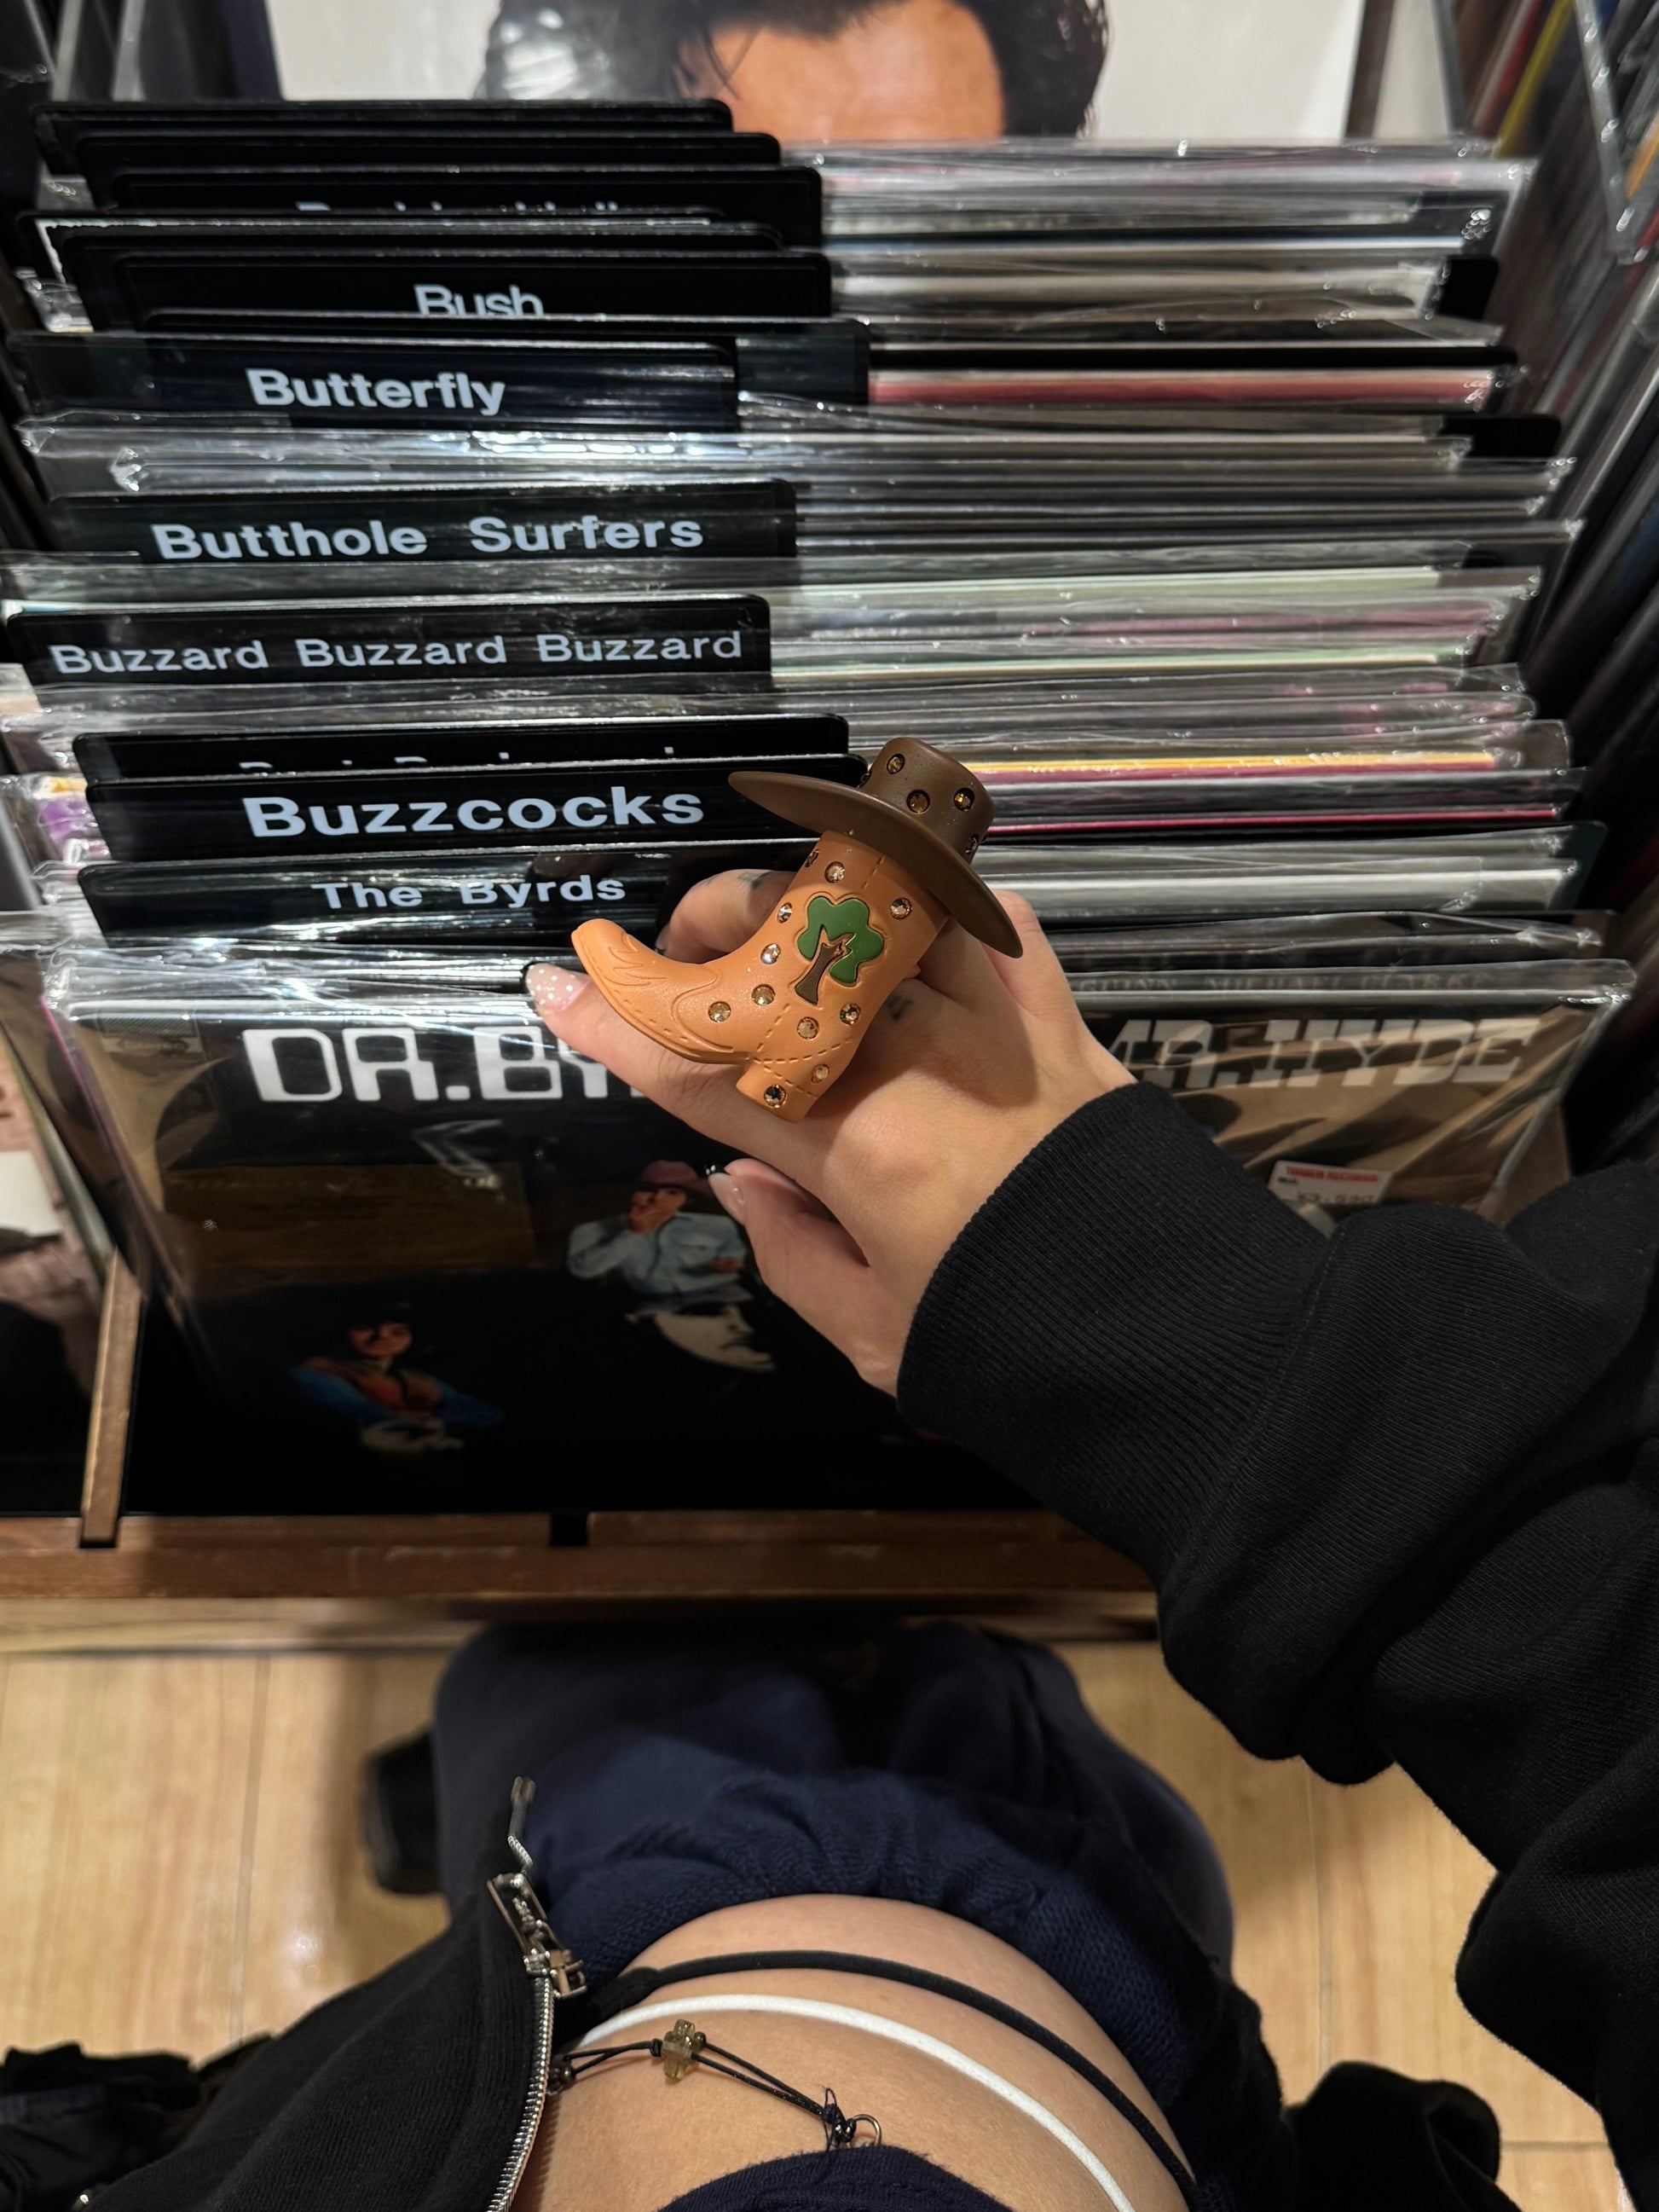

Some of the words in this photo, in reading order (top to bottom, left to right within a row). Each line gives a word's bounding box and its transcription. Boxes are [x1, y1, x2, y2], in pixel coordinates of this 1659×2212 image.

[413, 284, 545, 317] Bush
[246, 369, 506, 417] Butterfly
[151, 519, 428, 559] Butthole
[470, 514, 703, 553] Surfers
[49, 640, 269, 675] Buzzard
[297, 634, 507, 668] Buzzard
[537, 630, 743, 662] Buzzard
[242, 785, 704, 837] Buzzcocks
[311, 883, 423, 909] The
[457, 875, 626, 908] Byrds
[242, 1026, 645, 1102] DR.BY
